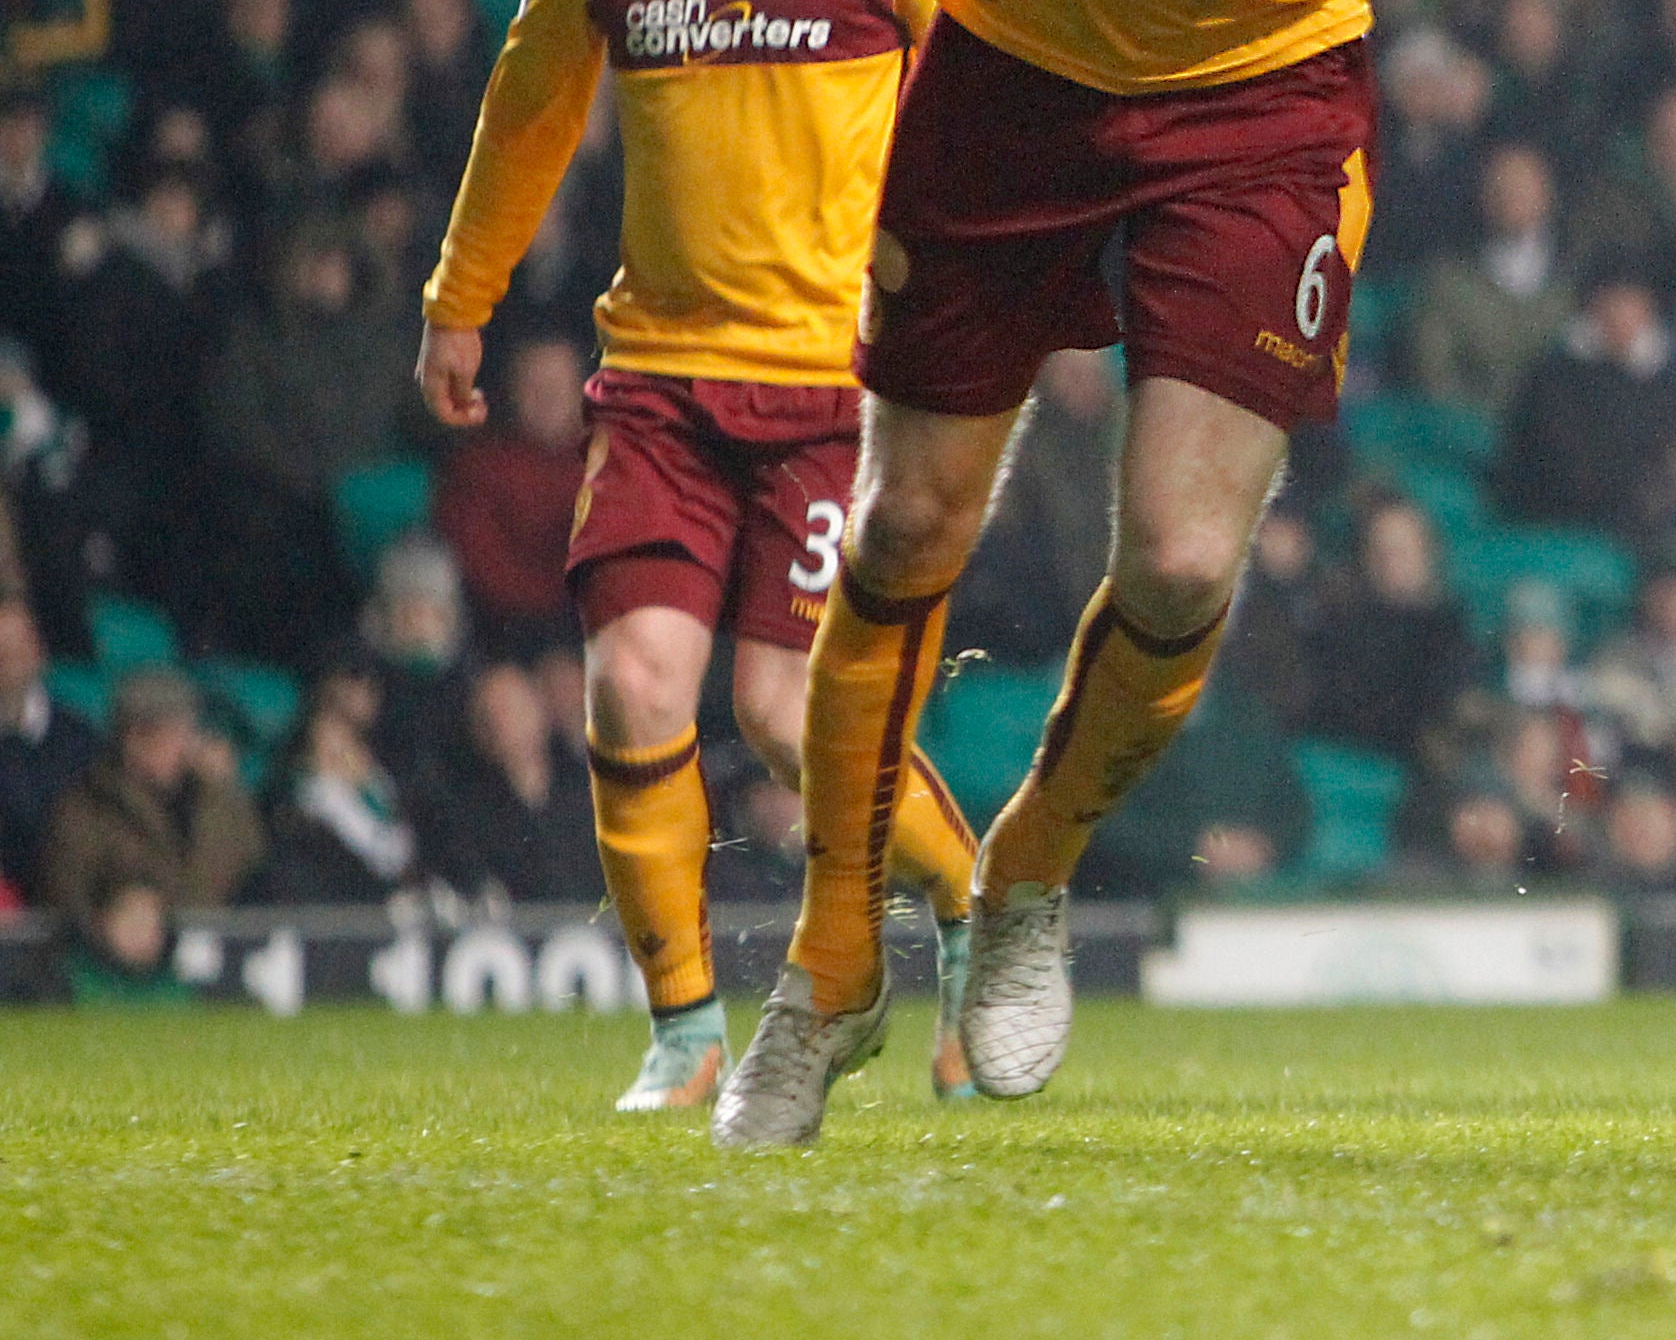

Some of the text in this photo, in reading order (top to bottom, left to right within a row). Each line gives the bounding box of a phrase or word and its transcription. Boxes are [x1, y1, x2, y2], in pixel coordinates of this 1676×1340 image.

[625, 11, 832, 57] converters
[1295, 234, 1336, 340] 6
[788, 499, 844, 593] 3
